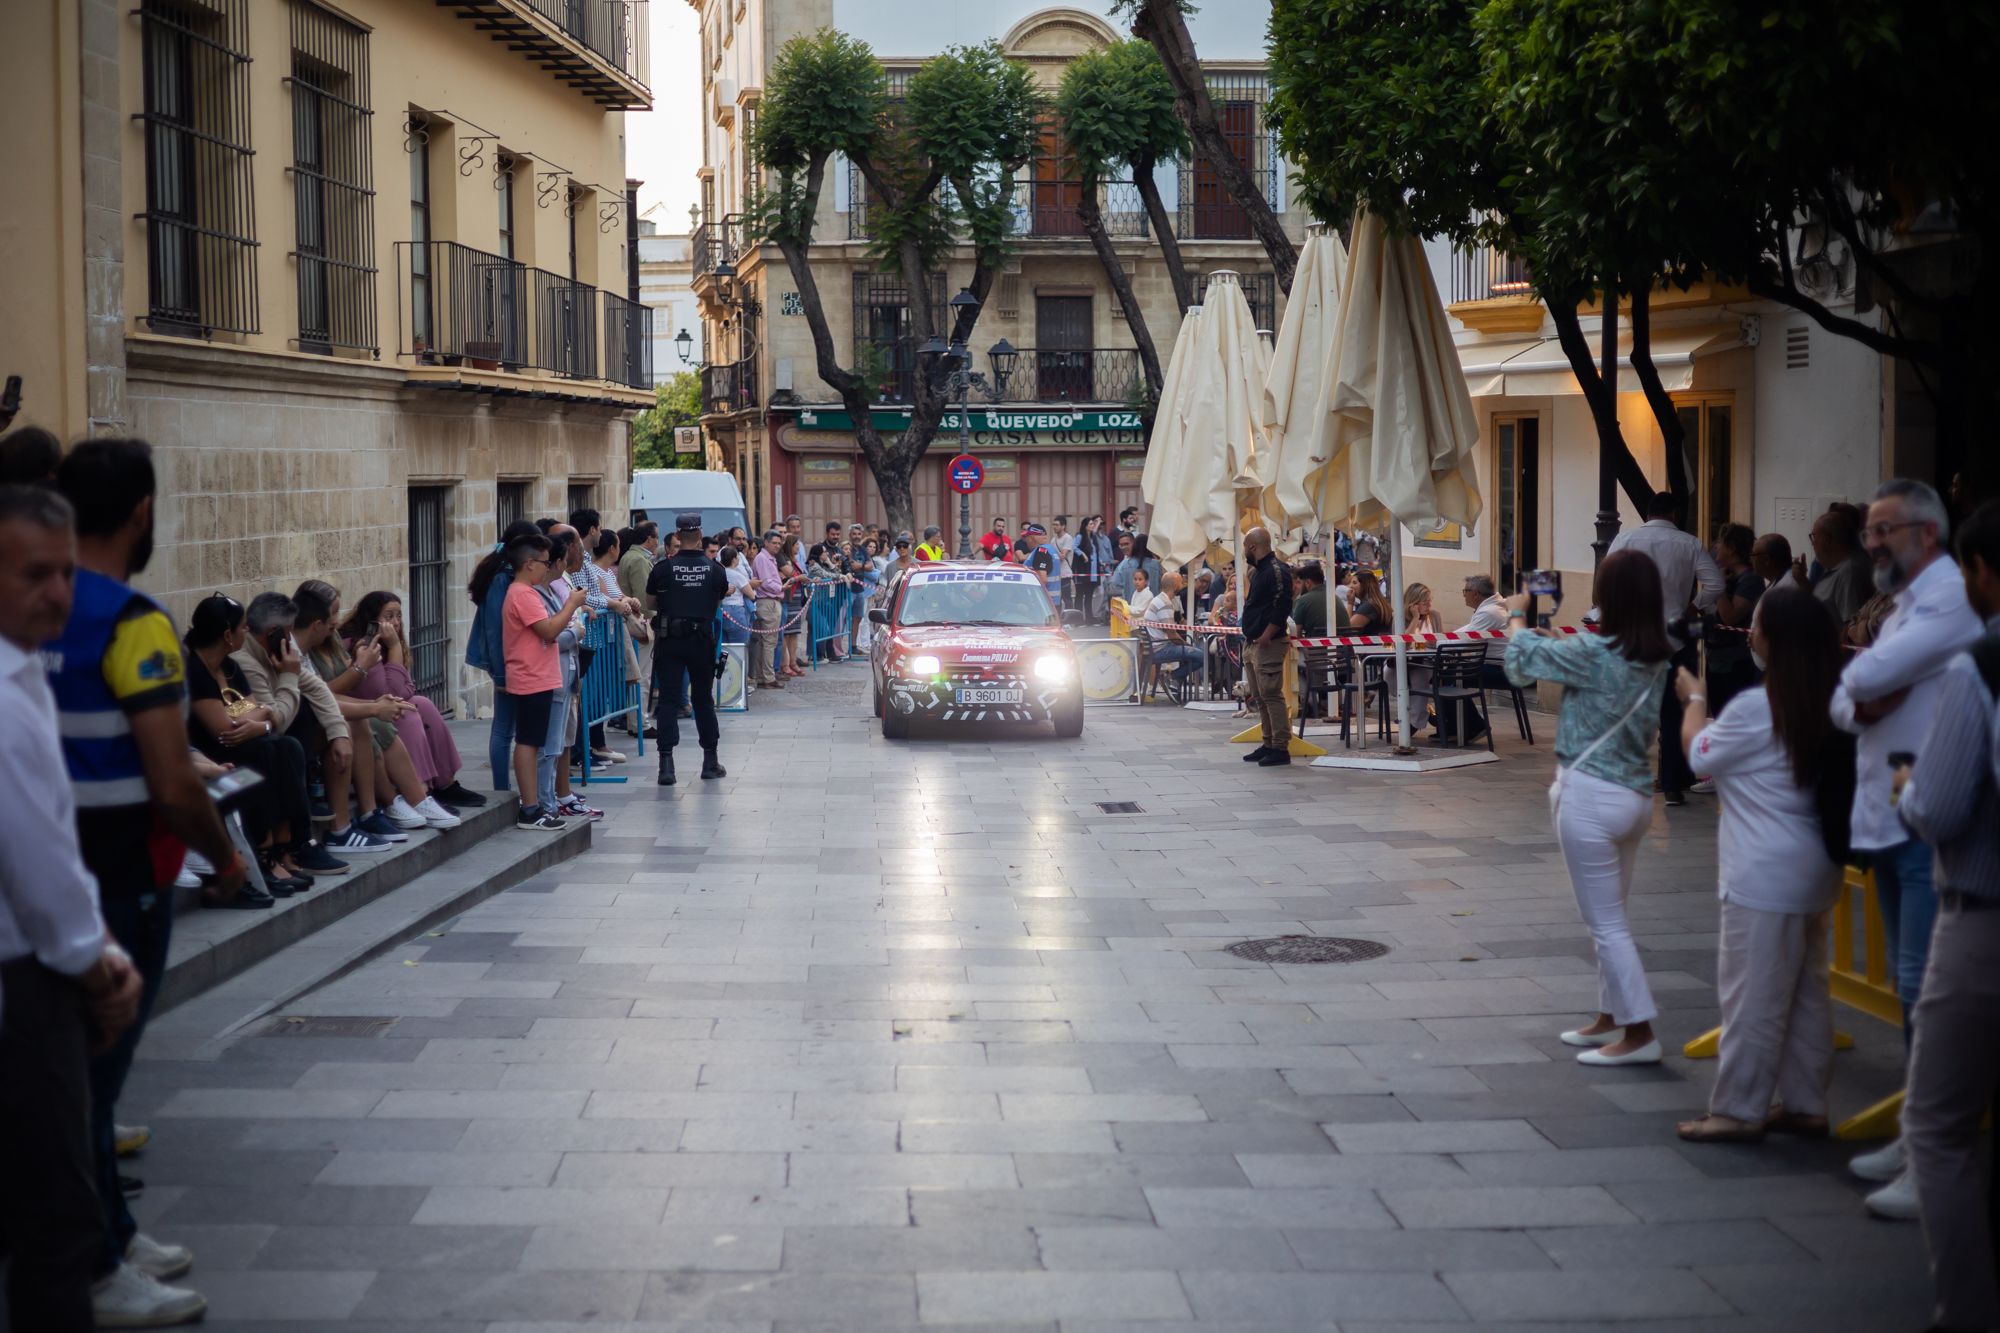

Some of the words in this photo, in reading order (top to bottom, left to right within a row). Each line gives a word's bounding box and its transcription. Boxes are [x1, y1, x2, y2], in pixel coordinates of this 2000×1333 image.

[783, 307, 805, 315] YER
[987, 415, 1074, 429] QUEVEDO
[974, 430, 1039, 445] CASA
[672, 565, 711, 573] POLICIA
[964, 690, 972, 702] B
[975, 690, 1001, 702] 9601
